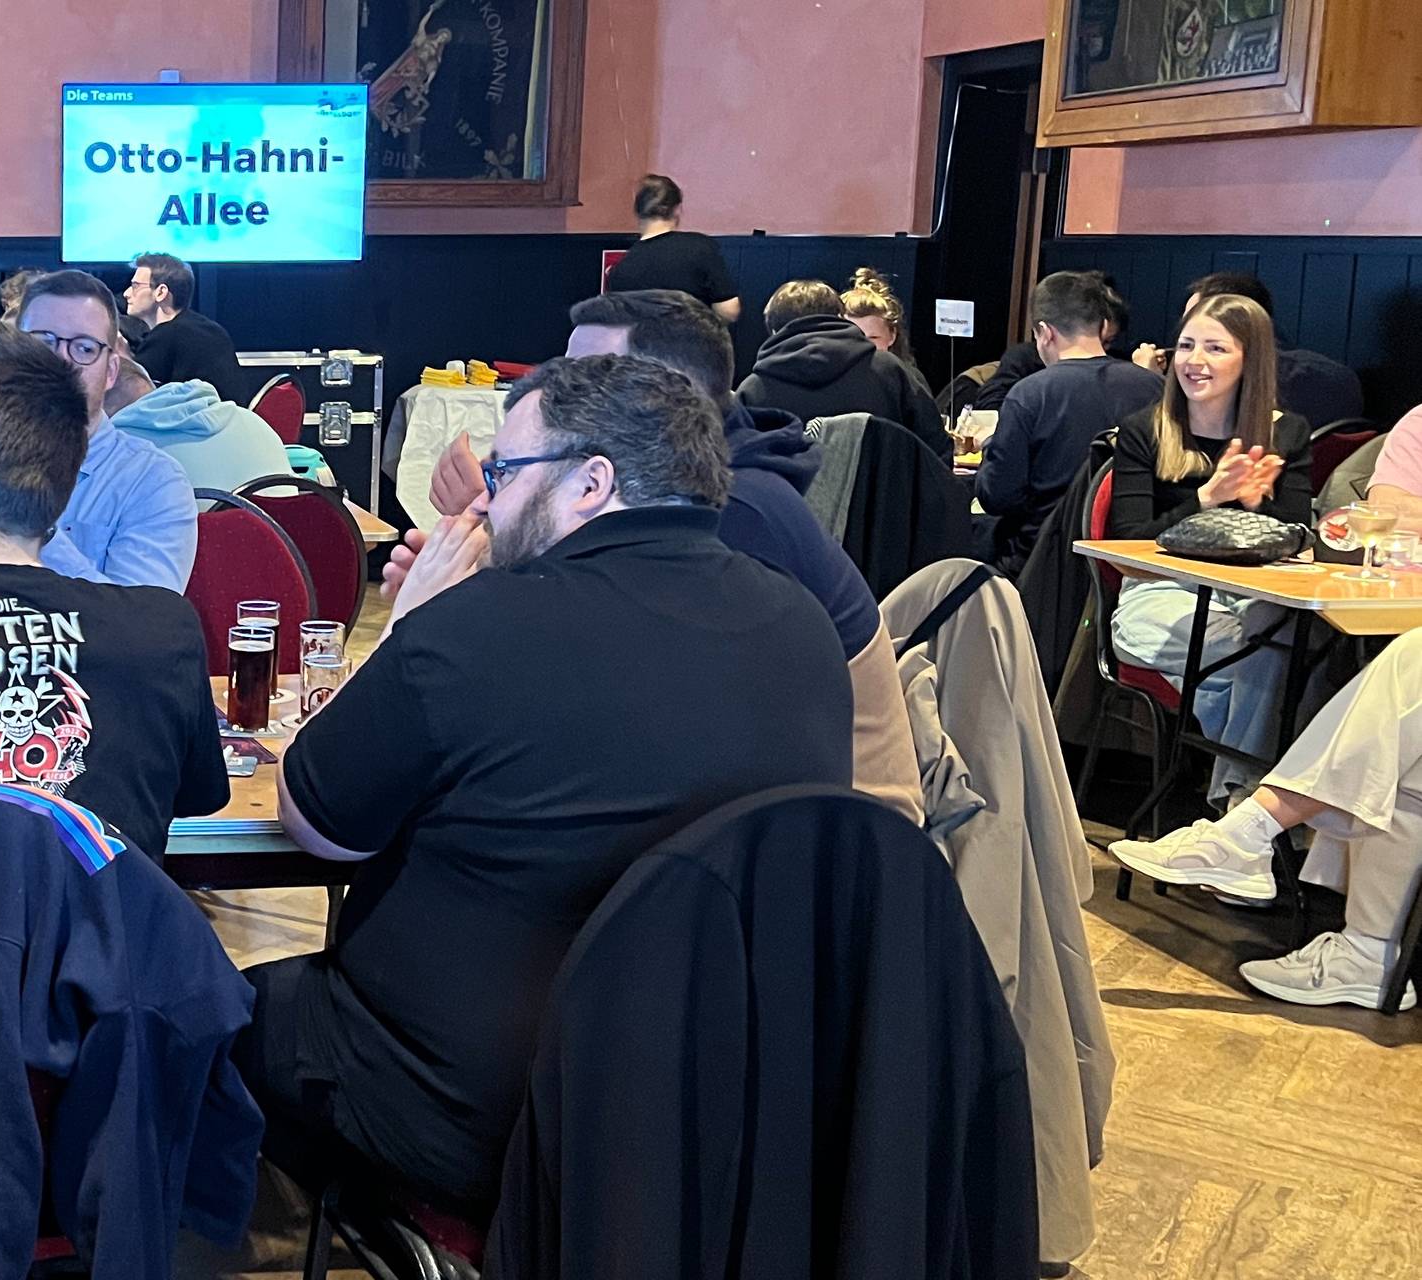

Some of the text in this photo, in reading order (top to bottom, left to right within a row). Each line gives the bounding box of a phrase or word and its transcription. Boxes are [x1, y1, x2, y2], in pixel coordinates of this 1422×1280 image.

[480, 1, 509, 104] KOMPANIE
[67, 89, 134, 101] Die Teams
[84, 137, 344, 173] Otto-Hahni-
[157, 193, 270, 226] Allee
